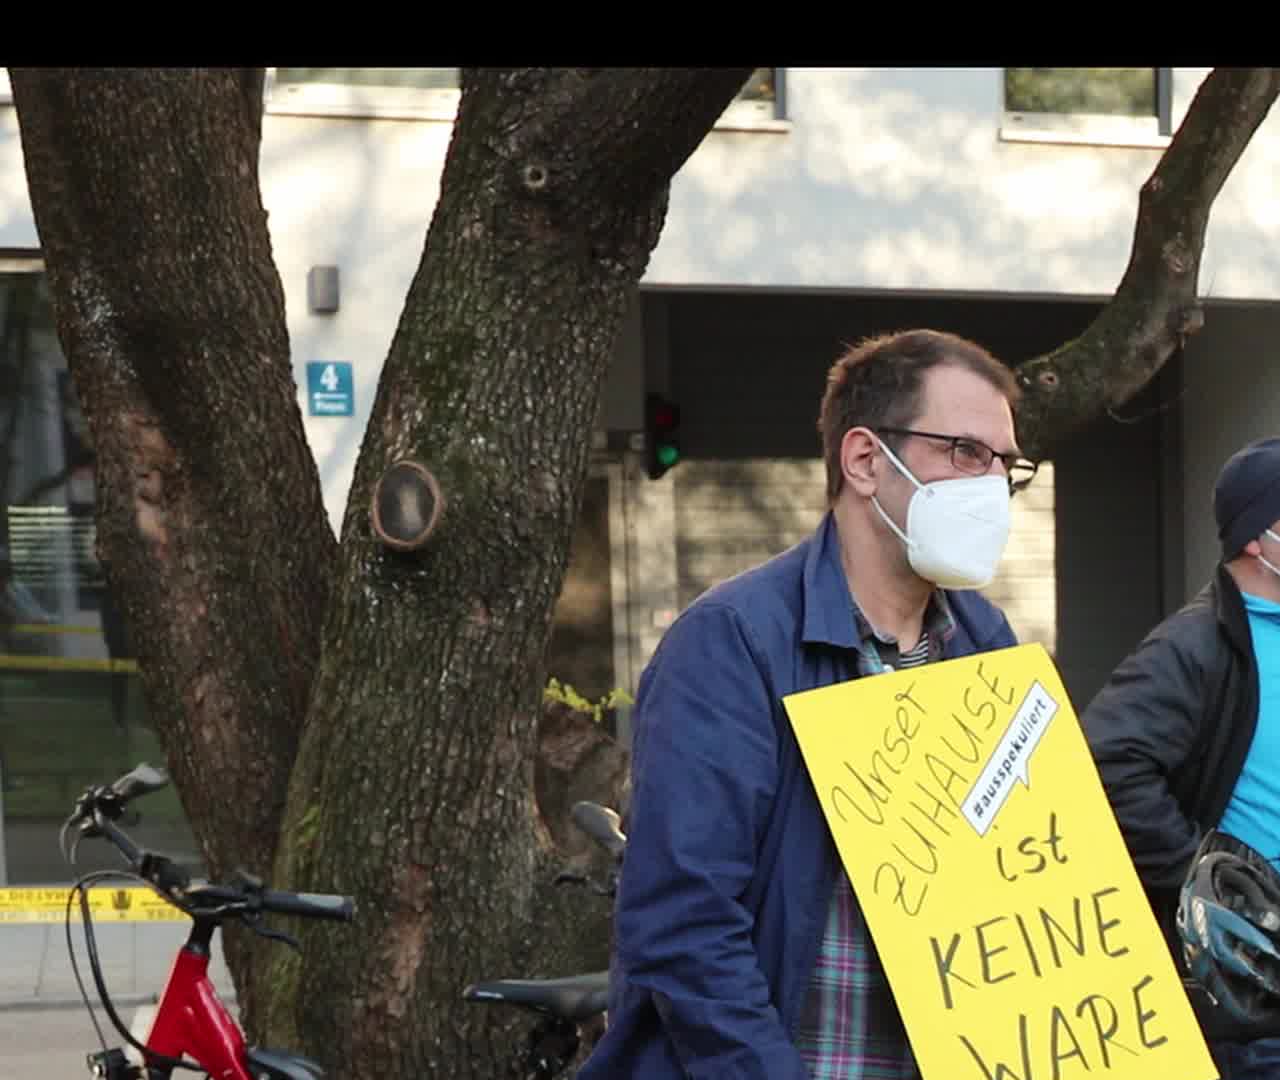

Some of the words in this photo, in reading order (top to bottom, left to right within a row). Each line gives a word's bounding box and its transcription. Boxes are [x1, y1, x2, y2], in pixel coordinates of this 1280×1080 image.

[320, 364, 339, 391] 4
[874, 661, 1015, 916] ZUHAUSE
[973, 697, 1048, 819] #ausspekuliert
[994, 812, 1068, 882] ist
[931, 887, 1129, 1010] KEINE
